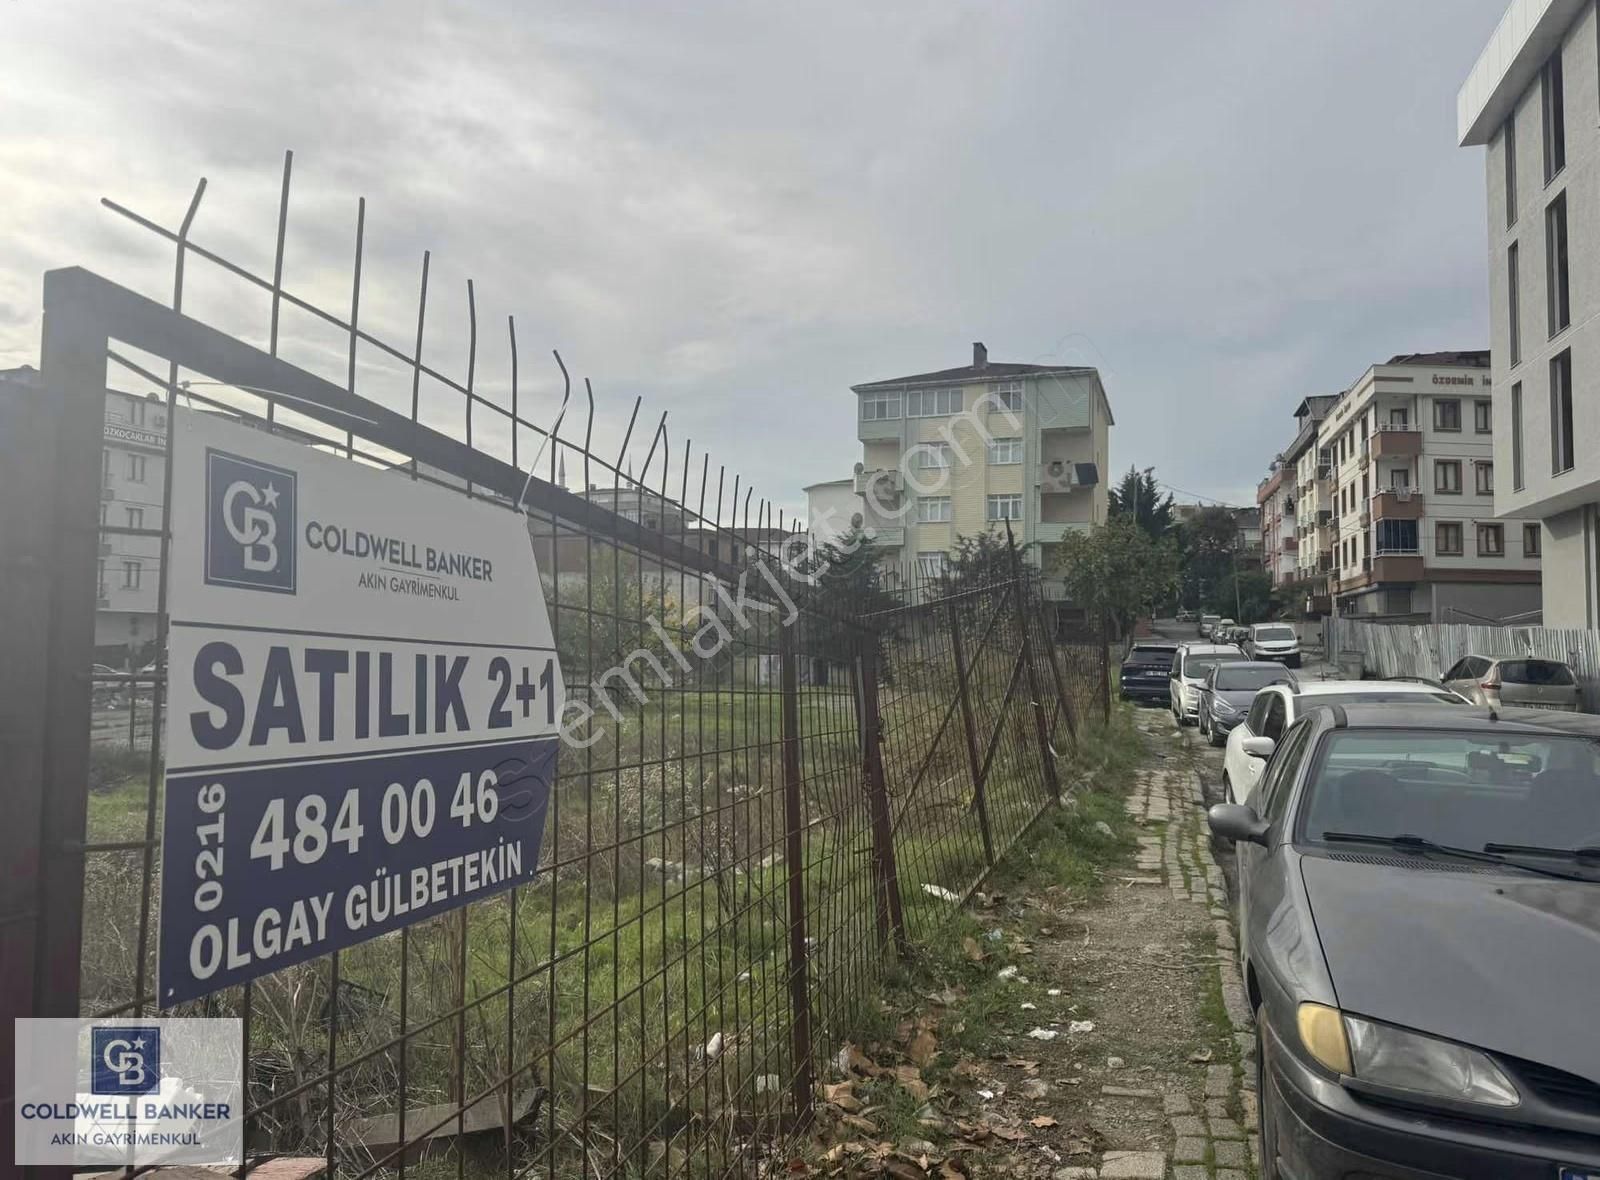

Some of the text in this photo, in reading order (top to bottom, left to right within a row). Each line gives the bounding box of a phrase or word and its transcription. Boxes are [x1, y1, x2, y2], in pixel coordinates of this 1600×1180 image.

[305, 521, 493, 582] COLDWELL BANKER
[358, 572, 460, 601] AKIN GAYRİMENKUL
[190, 640, 555, 751] SATILIK 2+1
[193, 782, 227, 912] 0216
[249, 787, 365, 871] 484
[381, 778, 436, 845] 00
[449, 768, 499, 828] 46
[189, 836, 523, 981] OLGAY GÜLBETEKİN
